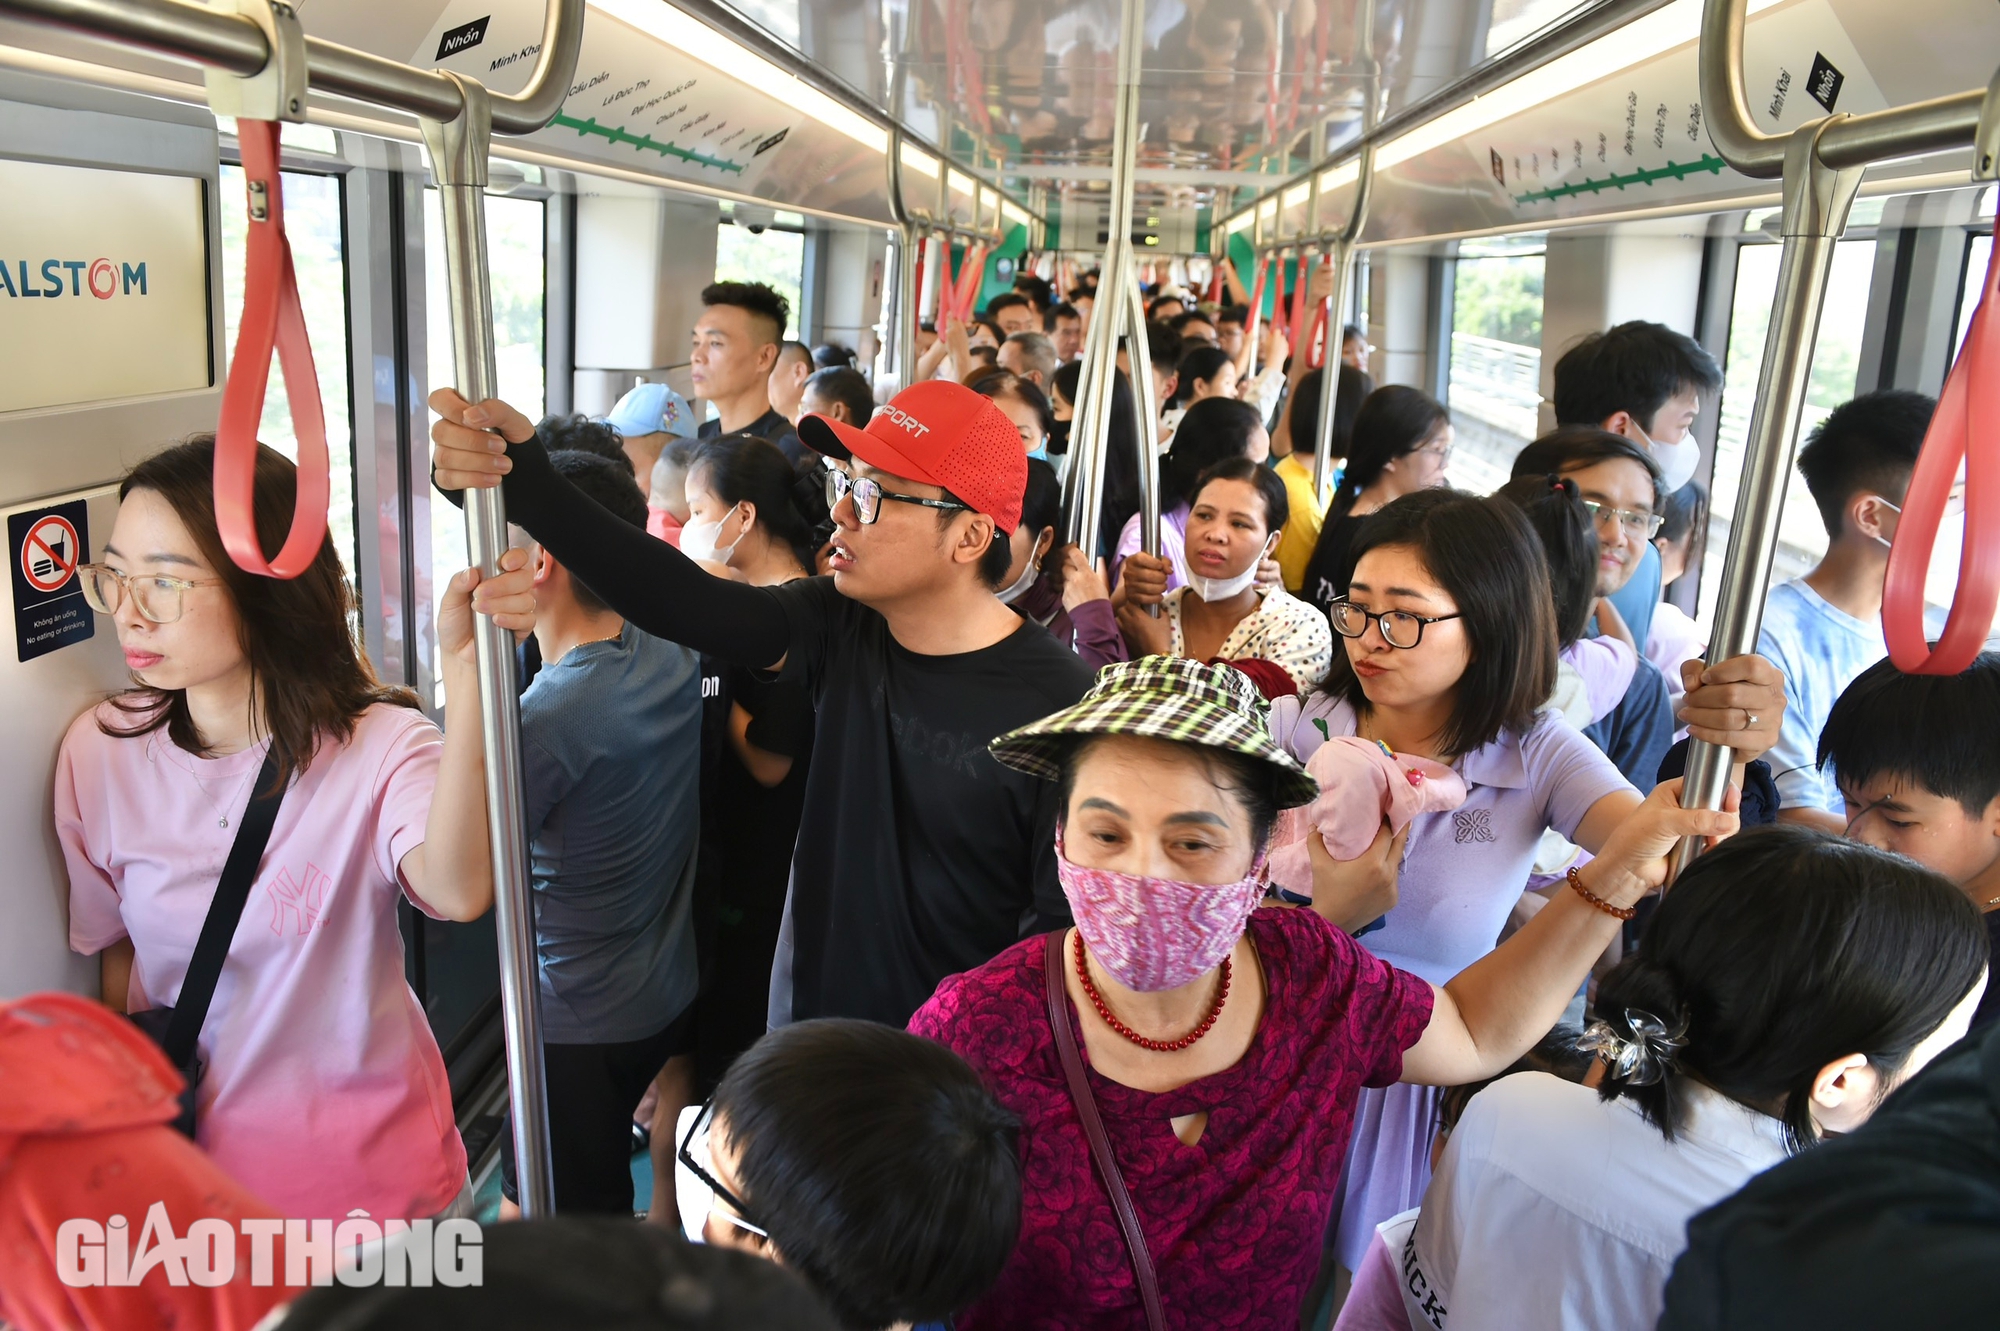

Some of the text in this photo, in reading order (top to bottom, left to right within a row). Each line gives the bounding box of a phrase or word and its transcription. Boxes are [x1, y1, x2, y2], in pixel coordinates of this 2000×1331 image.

[444, 27, 480, 52] Nhổn
[489, 44, 541, 72] Minh Kha
[1769, 67, 1792, 121] Minh Khai
[1816, 69, 1836, 103] Nhổn
[879, 404, 930, 438] PORT
[26, 637, 36, 645] No
[36, 630, 55, 642] eating
[62, 620, 85, 633] drinking
[33, 616, 53, 629] Không
